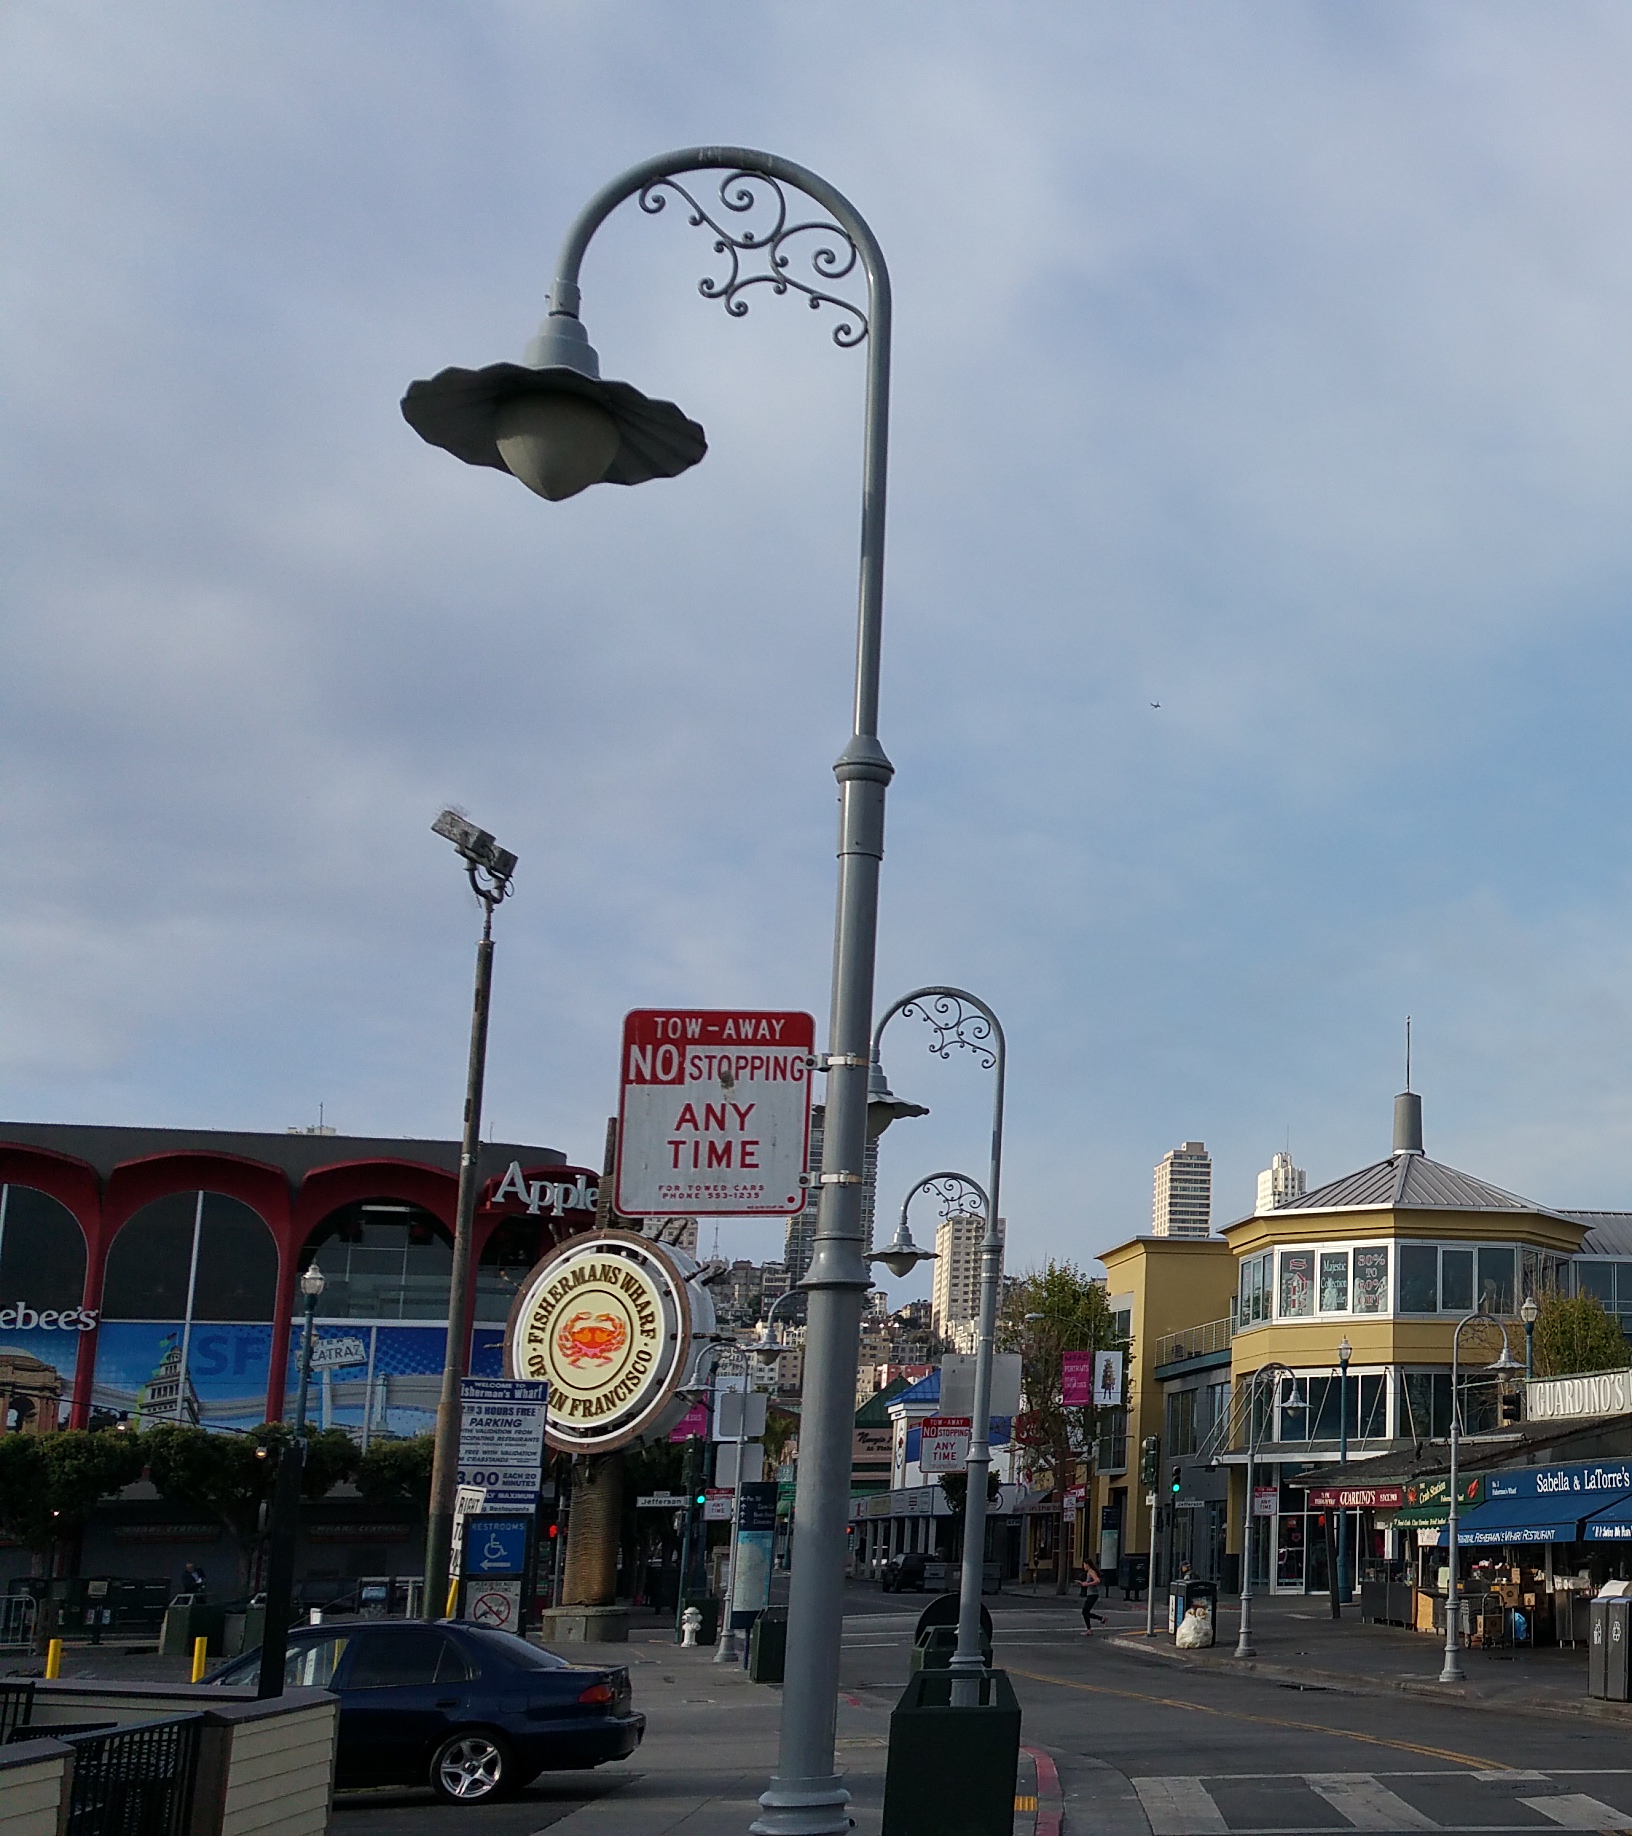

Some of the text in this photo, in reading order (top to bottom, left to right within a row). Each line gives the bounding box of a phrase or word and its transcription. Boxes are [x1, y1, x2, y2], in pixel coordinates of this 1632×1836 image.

[653, 1017, 785, 1040] TOW-AWAY
[628, 1043, 805, 1082] NO STOPPING
[674, 1102, 756, 1132] ANY
[666, 1140, 760, 1169] TIME
[492, 1160, 599, 1217] Apple
[1365, 1268, 1378, 1278] TO
[528, 1264, 657, 1346] FISHERMANS WHARF
[0, 1301, 99, 1331] ebee's
[199, 1334, 267, 1376] SF
[461, 1383, 543, 1399] isherman's Wharf
[528, 1349, 653, 1418] OF AN FRANCISCO
[1536, 1373, 1625, 1417] GUARDINO'S
[475, 1406, 482, 1415] 3
[484, 1406, 514, 1416] HOURS
[516, 1407, 536, 1417] FREE
[469, 1417, 523, 1428] PARKING
[923, 1426, 971, 1437] NO STOPPING
[934, 1441, 956, 1450] ANY
[933, 1452, 957, 1461] TIME
[457, 1471, 500, 1486] 3.00
[502, 1472, 524, 1480] EACH
[1536, 1466, 1631, 1493] Sabella & LaTorre's
[641, 1498, 682, 1506] Jefferson
[1339, 1490, 1376, 1506] GUARDINO'S
[472, 1522, 525, 1531] RESTROOMS
[1523, 1529, 1555, 1541] RESTAURANT
